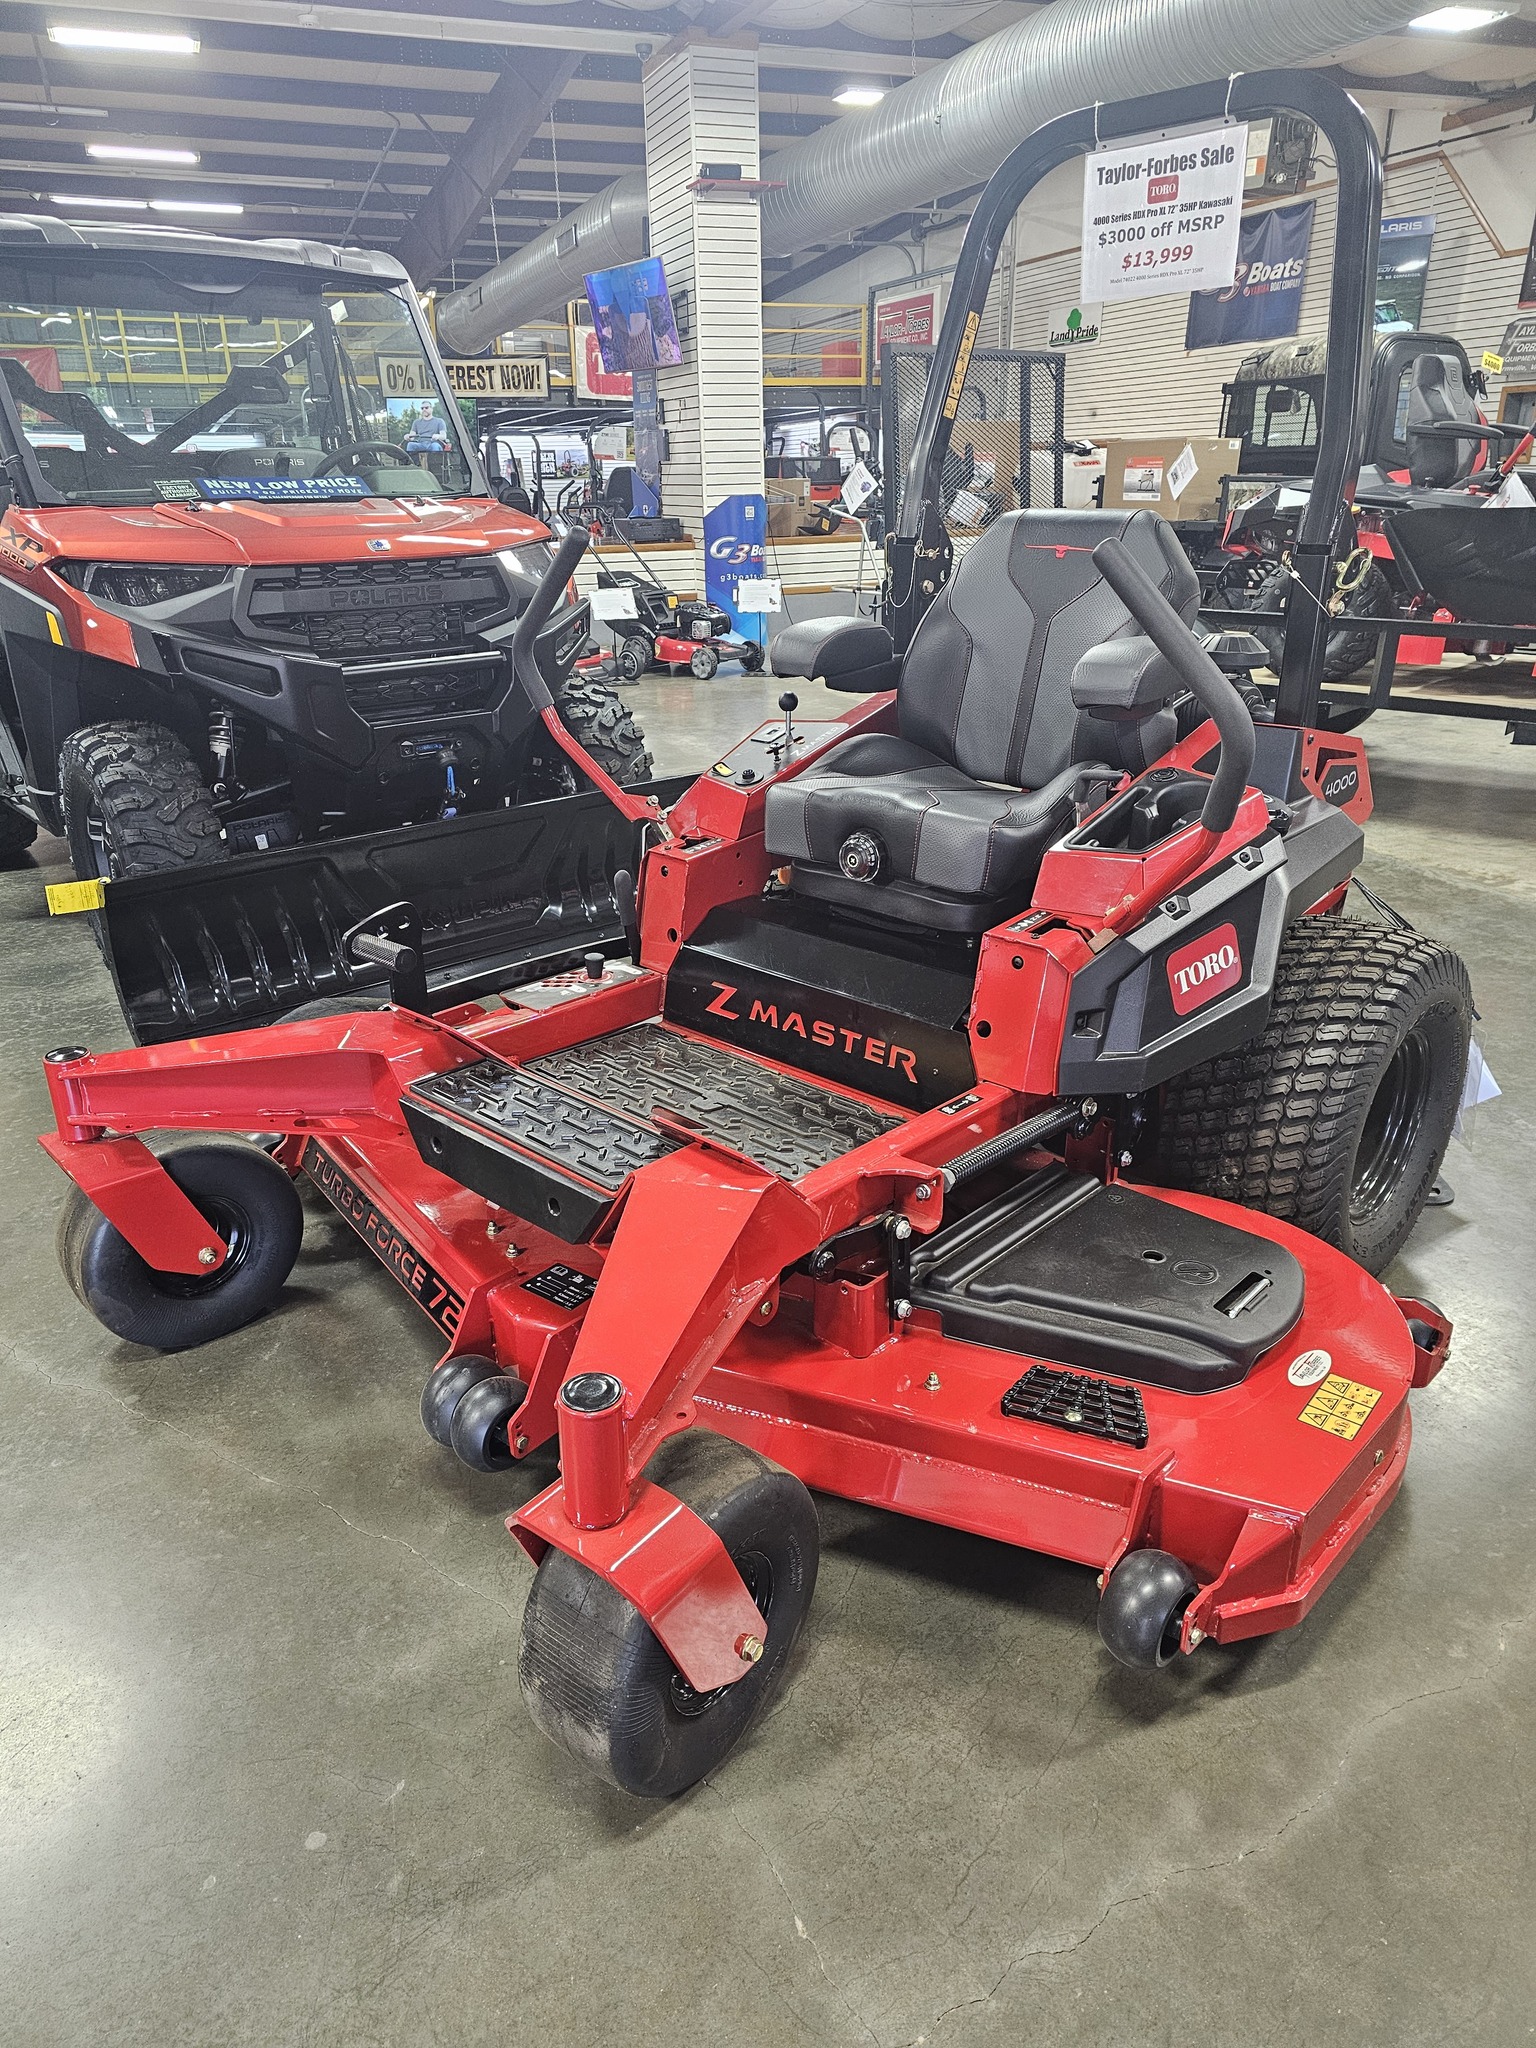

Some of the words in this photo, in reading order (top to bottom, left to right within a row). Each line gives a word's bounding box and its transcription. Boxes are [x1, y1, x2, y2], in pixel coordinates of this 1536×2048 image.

[1097, 153, 1198, 185] Taylor-Forbes
[1200, 145, 1234, 167] Sale
[1150, 183, 1176, 196] TORO
[1093, 215, 1110, 226] 4000
[1111, 213, 1131, 224] Series
[1133, 210, 1146, 220] HDX
[1147, 208, 1158, 218] Pro
[1158, 207, 1166, 216] XL
[1168, 204, 1178, 214] 72"
[1180, 202, 1197, 212] 35HP
[1198, 196, 1233, 210] Kawasaki
[1098, 226, 1145, 248] $3000
[1151, 221, 1173, 238] off
[1178, 214, 1225, 234] MSRP
[1381, 222, 1422, 233] LARIS
[1122, 244, 1193, 272] $13,999
[1246, 257, 1304, 284] Boats
[1050, 329, 1070, 342] Land
[1076, 325, 1098, 338] Pride
[386, 364, 414, 390] 0%
[418, 364, 495, 391] IEREST
[500, 364, 541, 390] NOW!
[203, 480, 250, 489] NEW
[255, 481, 299, 490] LOW
[302, 478, 361, 488] PRICE
[0, 526, 44, 553] XP
[710, 536, 751, 564] G3
[329, 584, 444, 608] POLARIS
[1325, 770, 1356, 797] 4000
[1174, 944, 1234, 994] TORO
[704, 981, 740, 1020] Z
[749, 999, 918, 1084] MASTER
[314, 1152, 365, 1221] TURBO
[366, 1212, 427, 1292] FORCE
